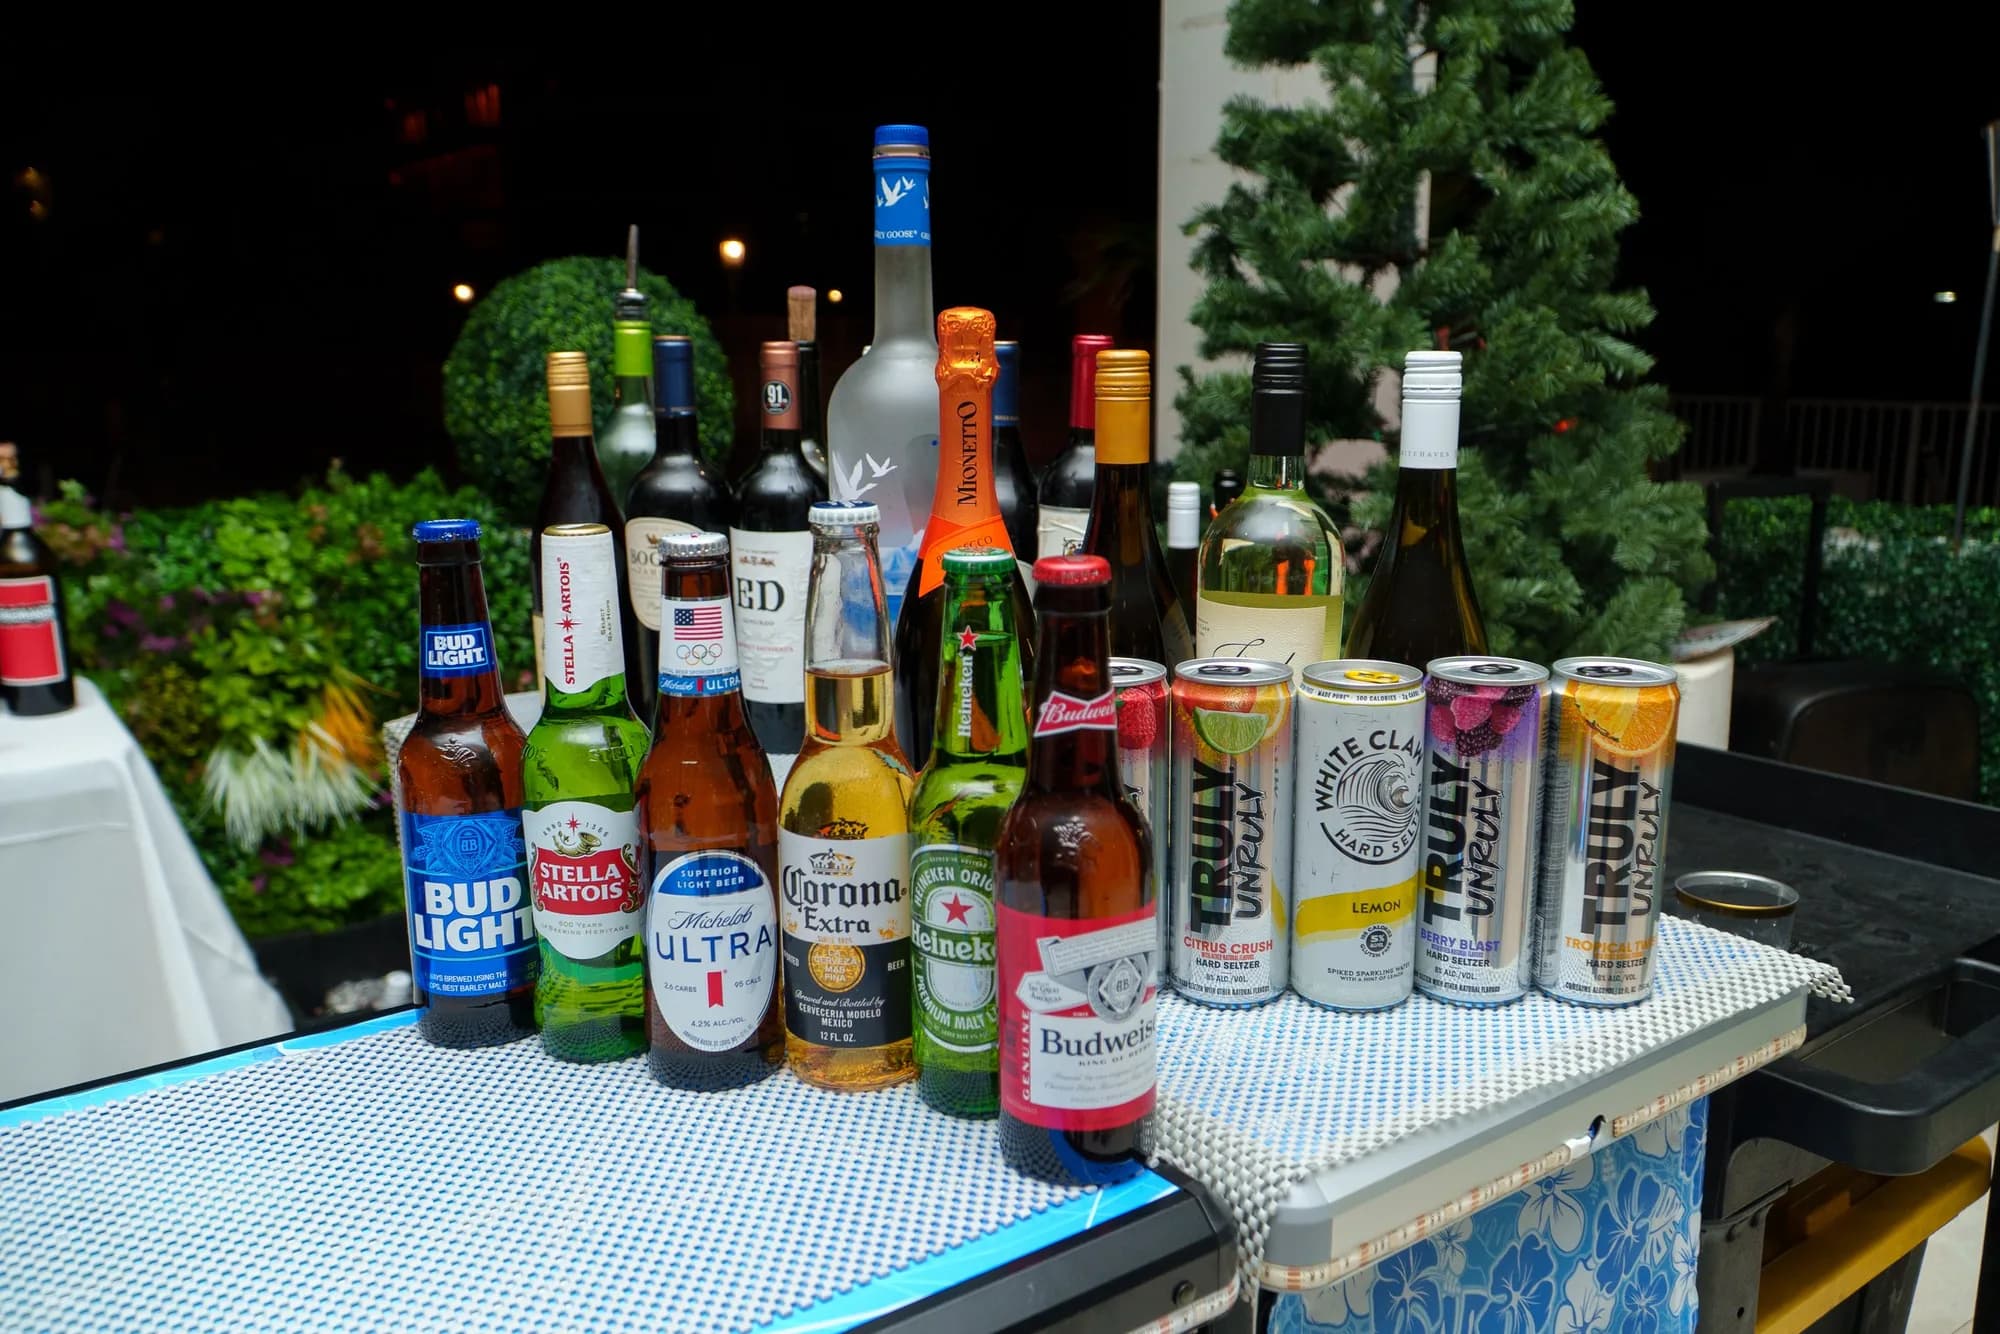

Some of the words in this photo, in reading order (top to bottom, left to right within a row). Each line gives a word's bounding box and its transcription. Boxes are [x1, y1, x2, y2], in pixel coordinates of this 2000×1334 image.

[767, 384, 782, 402] 91
[560, 562, 571, 614] ARTOIS
[434, 635, 475, 650] BUD
[428, 647, 484, 666] LIGHT
[564, 635, 575, 684] STELLA
[660, 678, 694, 690] Michelob
[706, 677, 740, 690] ULTRA
[958, 656, 974, 736] Heineken
[1314, 737, 1364, 811] WHITE
[1190, 758, 1235, 933] TRULY
[1334, 828, 1384, 858] HARD
[1424, 752, 1470, 925] TRULY
[1461, 776, 1503, 917] UNRULY
[1580, 758, 1640, 934] TRULY
[1630, 778, 1663, 916] UNRULY
[1230, 780, 1267, 920] UNRULY
[540, 862, 622, 882] STELLA
[680, 866, 738, 878] SUPERIOR
[542, 882, 622, 902] ARTOIS
[677, 880, 710, 889] LIGHT
[716, 876, 744, 888] BEER
[783, 865, 902, 908] Corona
[914, 867, 954, 907] HEINEKEN
[424, 876, 522, 916] BUD
[668, 904, 758, 930] Michelob
[1352, 900, 1400, 914] LEMON
[414, 906, 536, 952] LIGHT
[804, 906, 870, 934] Extra
[656, 924, 772, 962] ULTRA
[1184, 936, 1226, 953] CITRUS
[1230, 940, 1273, 954] CRUSH
[1420, 928, 1456, 947] BERRY
[1460, 939, 1500, 952] BLAST
[1565, 936, 1632, 953] TROPICAL
[887, 959, 905, 972] BEER
[1196, 958, 1221, 968] HARD
[1224, 960, 1260, 969] SELTZER
[1426, 950, 1449, 962] HARD
[1451, 957, 1490, 967] SELTZER
[1586, 959, 1614, 968] HARD
[1616, 958, 1647, 968] SELTZER
[745, 976, 762, 986] CALS
[1328, 968, 1354, 976] SPIKED
[1356, 968, 1394, 977] SPARKLING
[460, 984, 486, 992] BARLEY
[795, 988, 821, 1004] Brewed
[822, 998, 838, 1007] and
[840, 997, 874, 1007] Bottled
[874, 998, 885, 1008] by
[799, 1002, 844, 1019] CERVECERIA
[846, 1008, 881, 1019] MODELO
[916, 974, 951, 1027] PREMIUM
[954, 1012, 985, 1030] MALT
[821, 1017, 853, 1028] MEXICO
[820, 1031, 829, 1040] 12
[843, 1032, 856, 1042] OZ.
[1021, 1010, 1031, 1101] GENUINE
